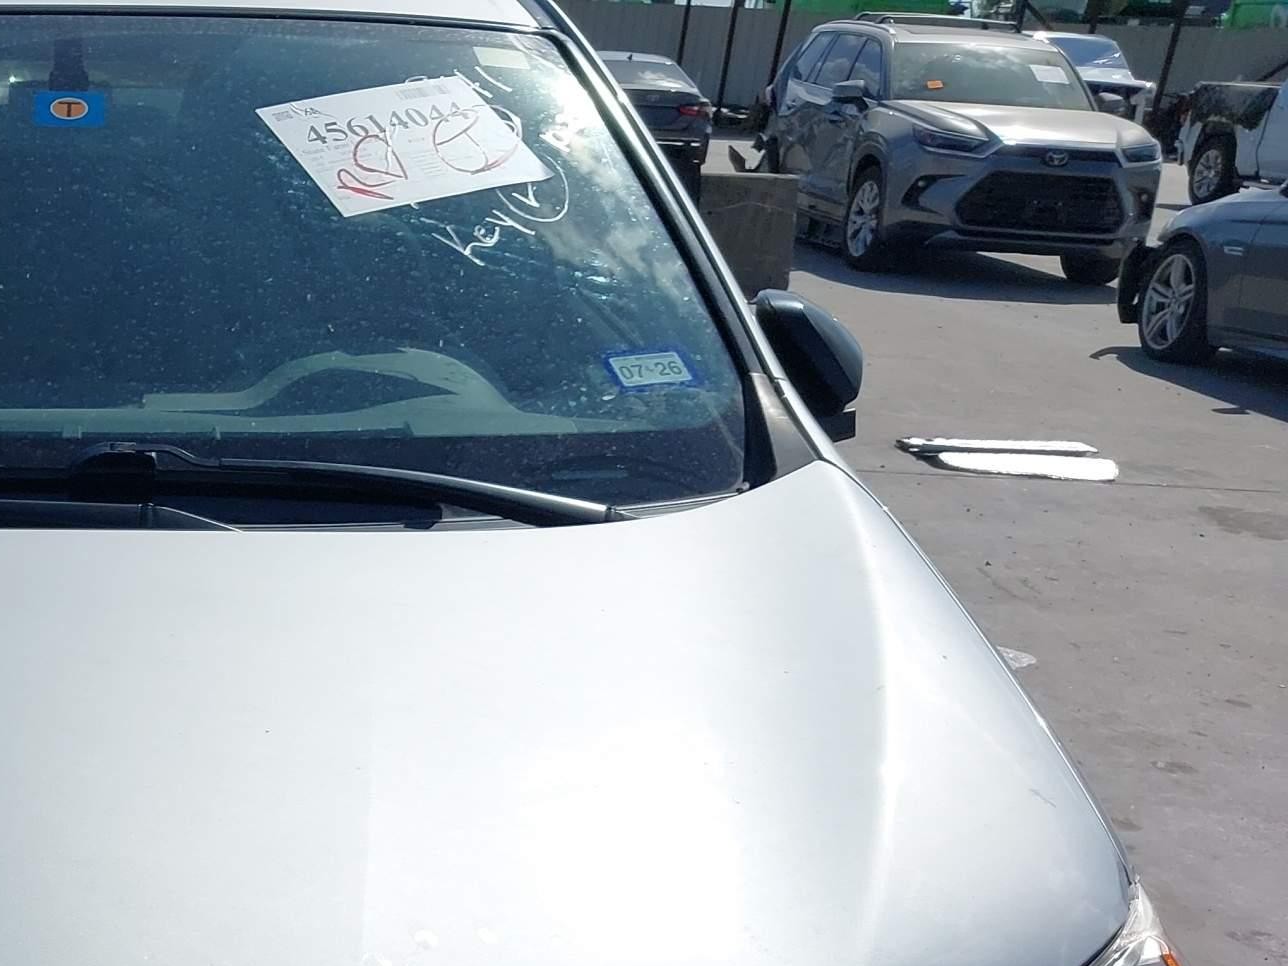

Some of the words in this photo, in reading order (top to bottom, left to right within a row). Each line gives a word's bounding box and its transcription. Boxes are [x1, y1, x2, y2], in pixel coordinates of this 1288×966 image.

[57, 101, 81, 117] T
[307, 101, 470, 144] 45614044
[618, 361, 683, 380] 07-26
